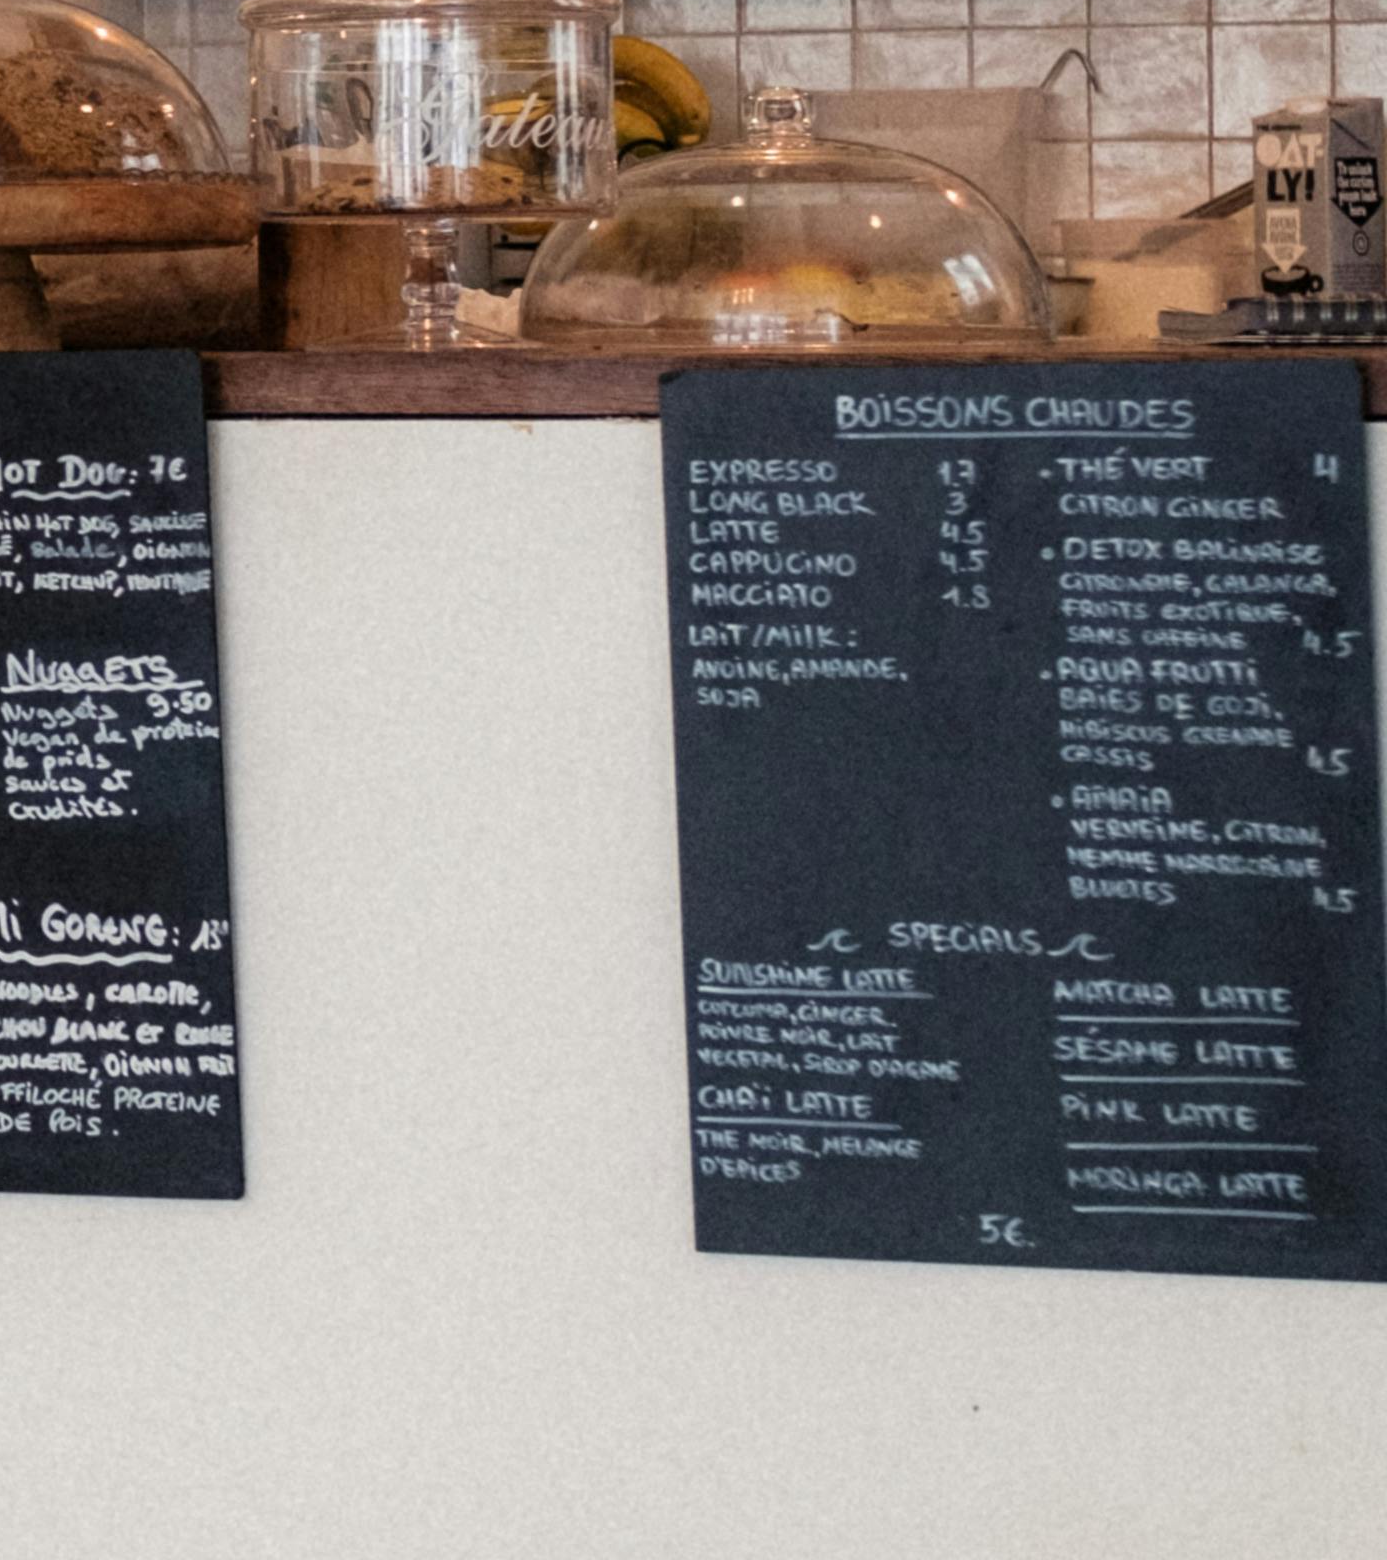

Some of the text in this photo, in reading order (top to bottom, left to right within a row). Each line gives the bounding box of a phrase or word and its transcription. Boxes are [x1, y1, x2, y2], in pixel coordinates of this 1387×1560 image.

[1267, 168, 1315, 202] LY!
[1026, 397, 1196, 430] CHAUDES
[149, 454, 188, 482] 7€
[689, 459, 838, 486] EXPRESSO
[1056, 446, 1339, 483] THÉ VERT 4
[690, 490, 969, 516] LONG BLACK 3
[690, 520, 780, 545] LATTE
[1063, 537, 1164, 561] DETOX
[941, 585, 991, 609] 1.8
[1067, 626, 1132, 645] SANS
[1056, 656, 1141, 683] AQUA
[146, 691, 213, 718] 9.50
[697, 686, 761, 708] SOJA
[94, 722, 127, 743] de
[3, 746, 29, 769] de
[101, 769, 133, 790] et
[843, 968, 917, 991] LATTE
[1053, 980, 1294, 1013] MATCHA LATTE
[1053, 1026, 1297, 1070] SÉSAME LATTE
[785, 1092, 874, 1119] LATTE
[1163, 1103, 1259, 1132] LATTE
[1219, 1172, 1308, 1202] LATTE
